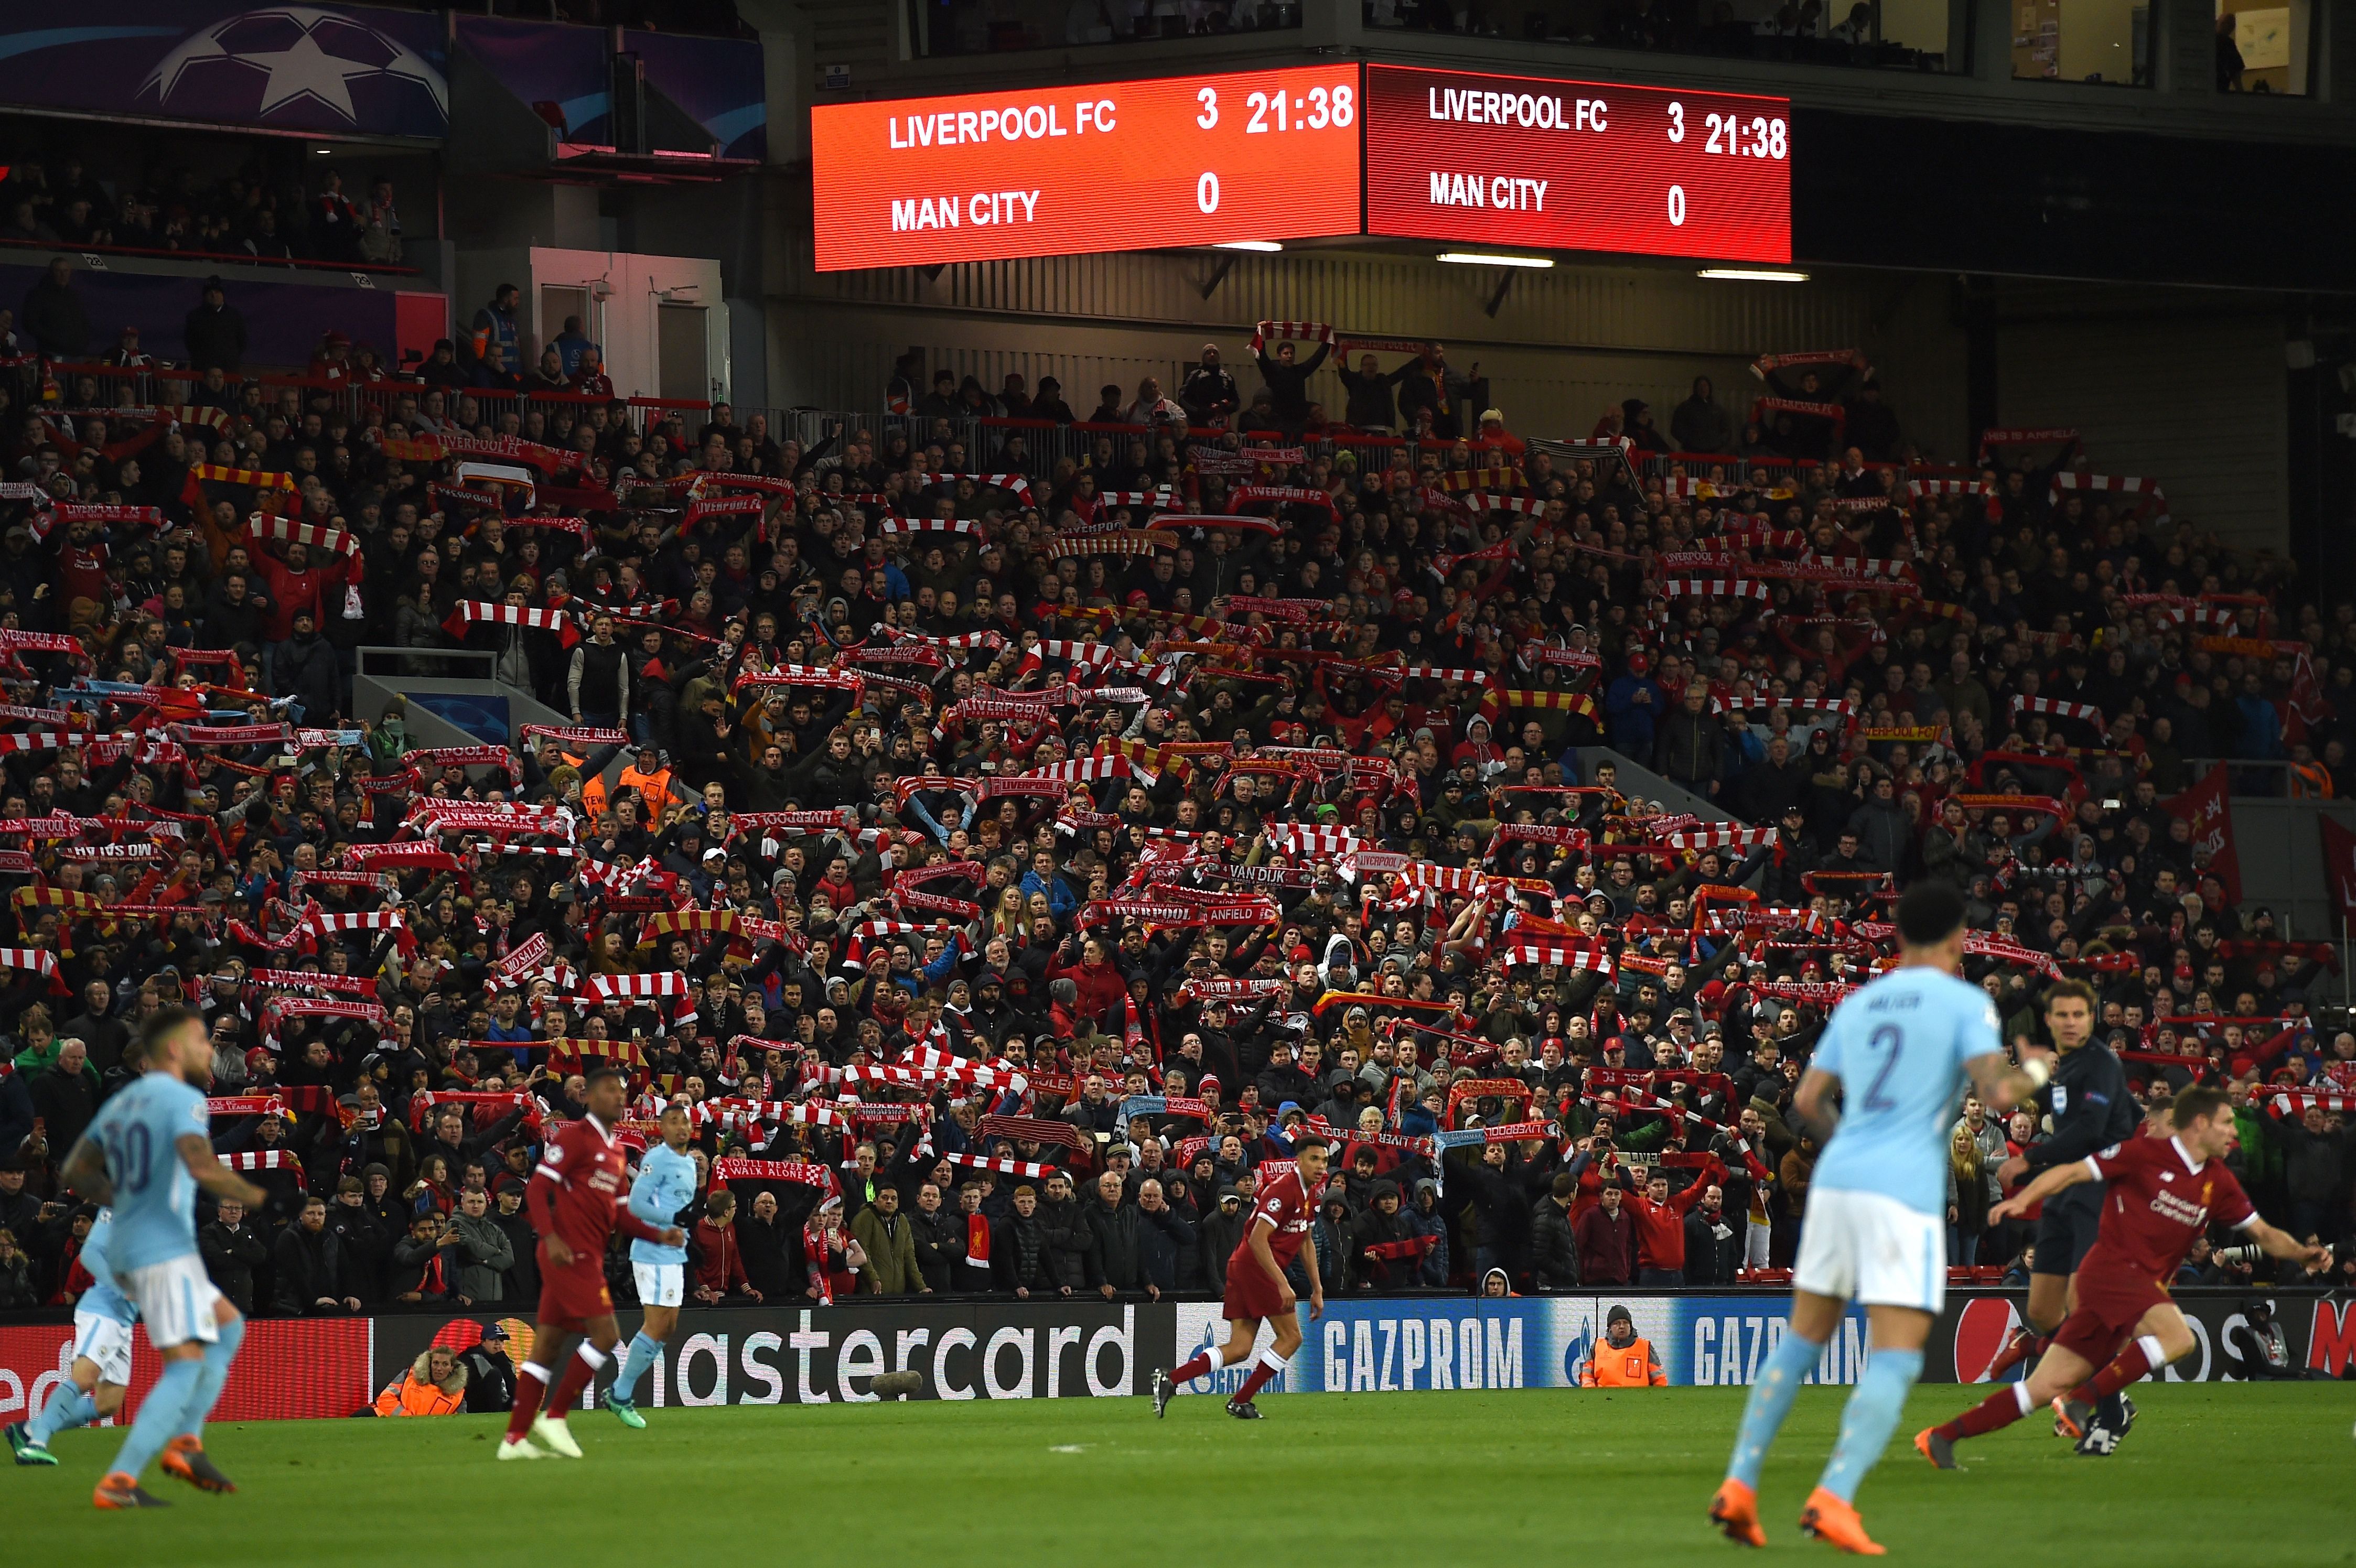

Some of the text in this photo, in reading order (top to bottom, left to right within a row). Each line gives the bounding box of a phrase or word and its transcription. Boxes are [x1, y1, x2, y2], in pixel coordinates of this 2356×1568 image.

[890, 85, 1353, 148] LIVERPOOL FC 3 21:38
[1430, 88, 1787, 159] LIVERPOOL FC 3 21:38
[892, 172, 1219, 231] MAN CITY 0
[1430, 172, 1685, 225] MAN CITY 0
[87, 257, 103, 266] 28
[355, 276, 370, 285] 29
[436, 435, 521, 456] LIVERPOOL FC
[1243, 450, 1281, 459] LIVERPOOL
[716, 473, 763, 484] SCOUSERS
[1247, 486, 1322, 501] LIVERPOOL FC
[1666, 551, 1730, 563] LIVERPOOL FC
[57, 633, 70, 645] FC
[891, 647, 923, 657] KLOPP
[1004, 691, 1056, 702] LIVERPOOL FC
[965, 701, 1042, 714] LIVERPOOL
[37, 708, 50, 720] WALK
[50, 710, 67, 722] ALONE
[236, 730, 257, 739] 1892
[560, 727, 623, 739] ALLEZ ALLEZ
[1918, 727, 1933, 738] FC
[488, 744, 505, 757] FC
[1296, 754, 1384, 769] LIVERPOL FC
[1002, 781, 1053, 792] LIVERPOOL
[439, 812, 534, 825] LIVERPOOL FC
[745, 813, 832, 828] LIVERPOOL FC
[69, 819, 80, 832] FC
[1505, 823, 1577, 839] LIVERPOOL FC
[130, 843, 151, 856] MO
[1359, 855, 1396, 868] LIVERPOOL
[1230, 864, 1256, 879] VAN
[1257, 867, 1285, 883] DIJK
[1523, 879, 1544, 890] FC
[905, 889, 970, 910] LIVERPOOL FC
[1106, 906, 1191, 922] LIVERPOOL
[1211, 908, 1253, 921] ANFIELD
[757, 928, 776, 938] ALONE
[762, 920, 779, 933] FC
[507, 937, 546, 974] MO SALAH
[1973, 941, 2041, 960] LIVERPOOL FC
[340, 983, 361, 991] ALONE
[1187, 980, 1231, 996] 8 STEVEN
[1762, 982, 1830, 993] LIVERPOOL
[294, 998, 368, 1016] LIVERPOOL FC
[1864, 1022, 1905, 1112] 2
[1602, 1072, 1616, 1083] FC
[866, 1112, 902, 1122] NEVER WALK
[1321, 1125, 1409, 1145] LIVER POOL
[1486, 1124, 1541, 1137] LIVERPOOL
[724, 1158, 803, 1172] YOU'LL NEVER
[730, 1166, 803, 1180] WALK ALONE
[1324, 1317, 1523, 1392] GAZPROM
